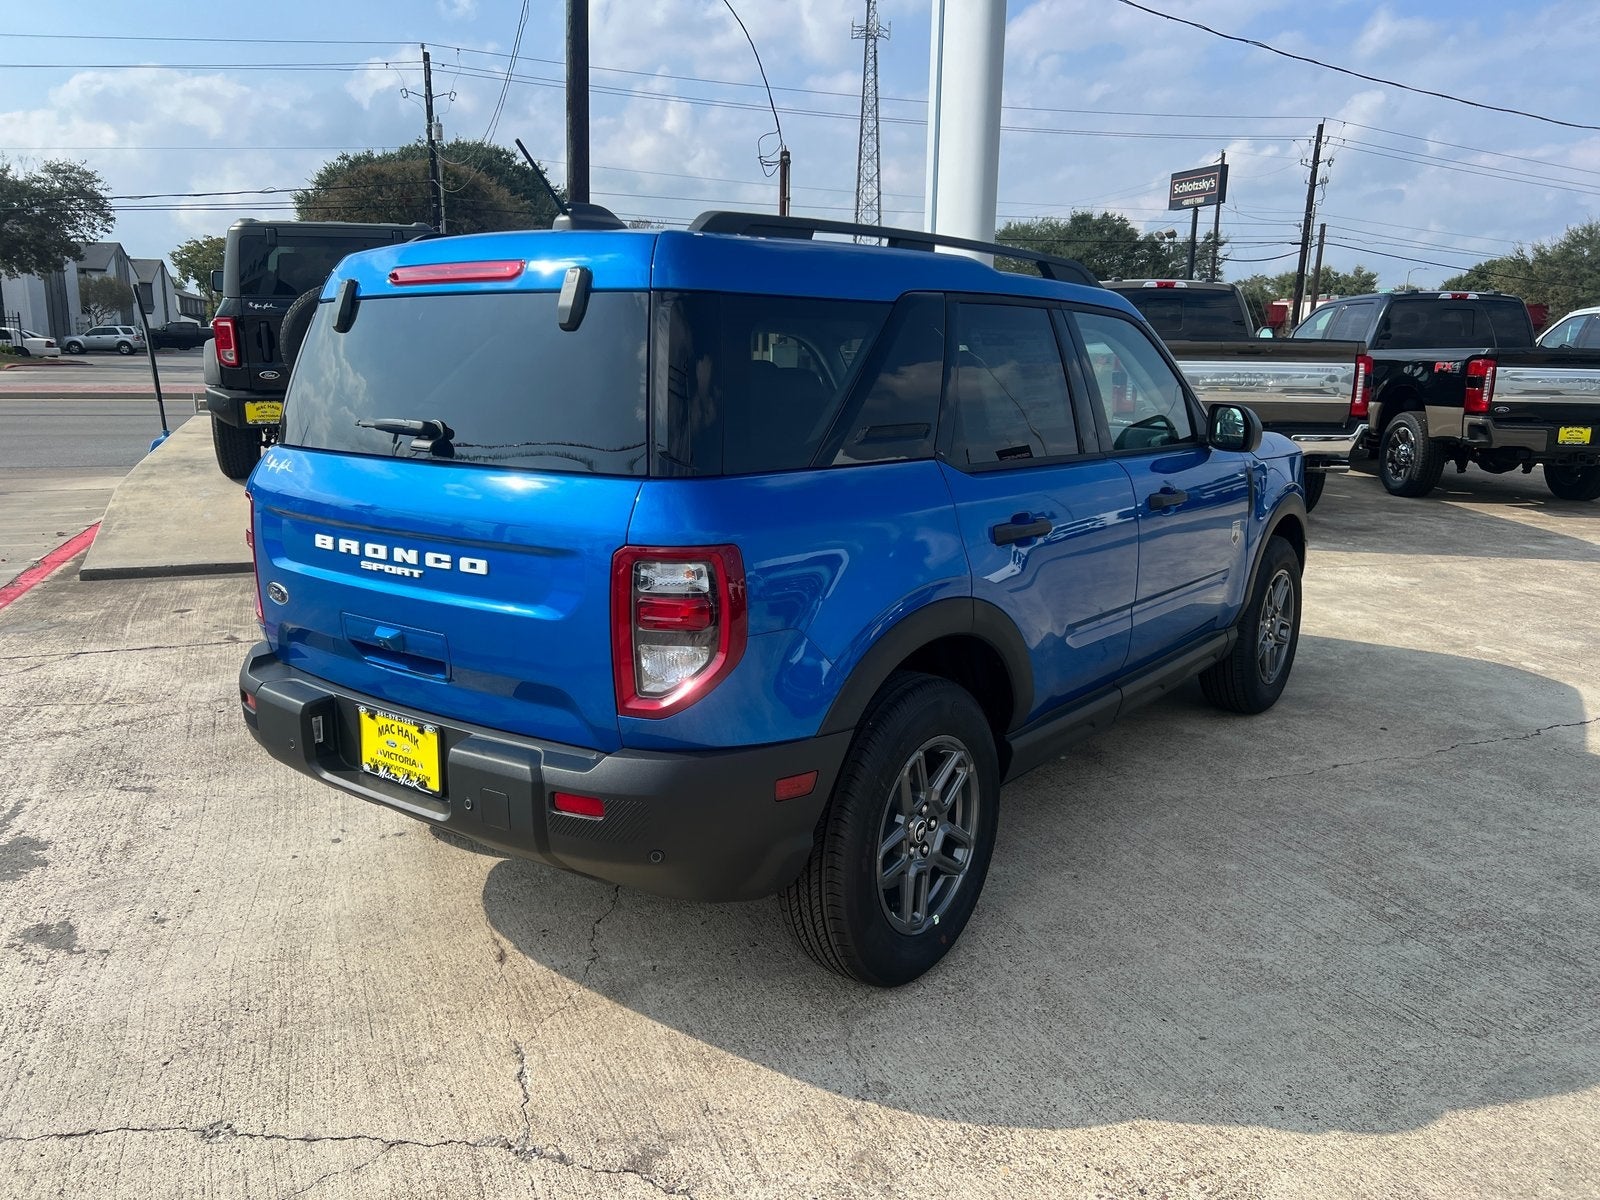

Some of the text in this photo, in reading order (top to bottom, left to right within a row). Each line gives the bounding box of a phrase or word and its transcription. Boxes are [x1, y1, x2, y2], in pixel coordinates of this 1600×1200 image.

[1174, 178, 1215, 194] Schlotzsky's
[1434, 361, 1461, 373] FX4
[315, 533, 488, 575] BRONCO
[360, 561, 424, 578] SPORT
[378, 724, 396, 737] MAC
[397, 725, 420, 749] HAIK
[382, 749, 417, 768] VICTORIA
